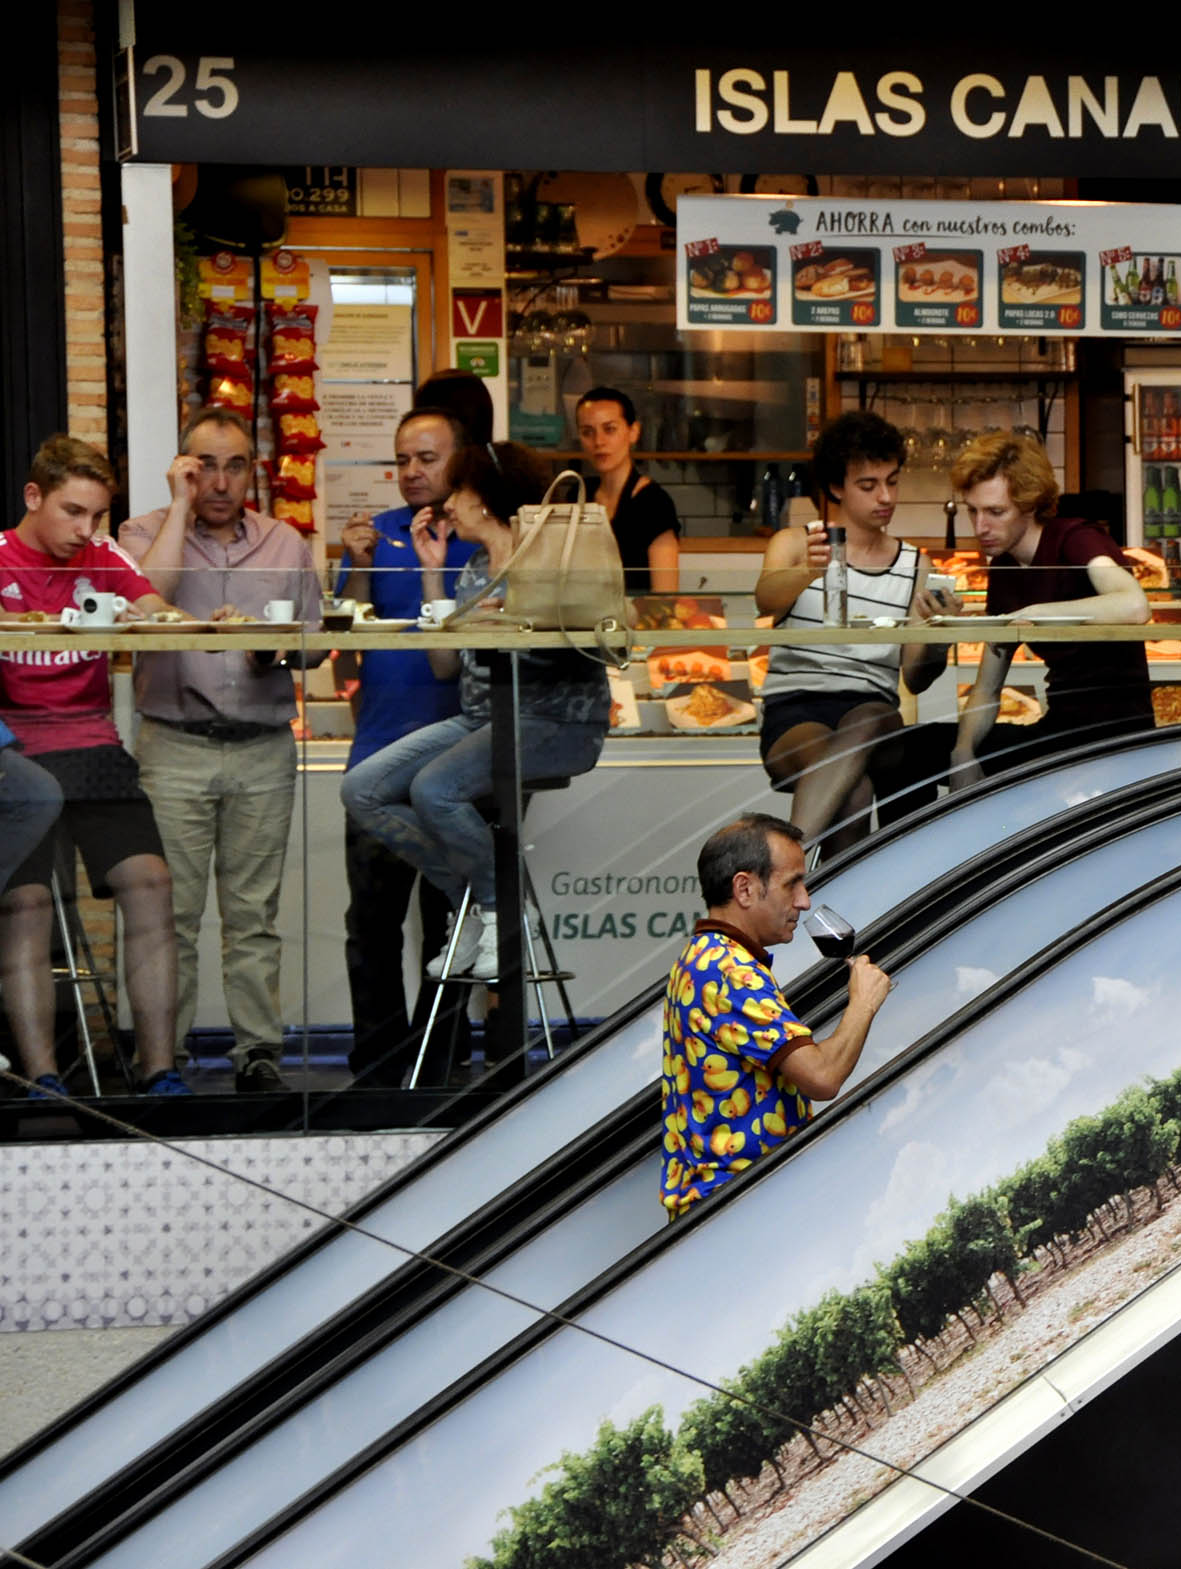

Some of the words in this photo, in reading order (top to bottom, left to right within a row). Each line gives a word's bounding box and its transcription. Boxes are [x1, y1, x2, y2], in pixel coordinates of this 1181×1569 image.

[142, 56, 240, 120] 25
[695, 68, 927, 137] ISLAS
[815, 210, 894, 233] AHORRA
[902, 218, 932, 233] con
[936, 215, 1008, 236] nuestros
[1012, 215, 1077, 237] combos:
[456, 300, 488, 335] V
[552, 912, 637, 940] ISLAS
[645, 910, 703, 940] CA
